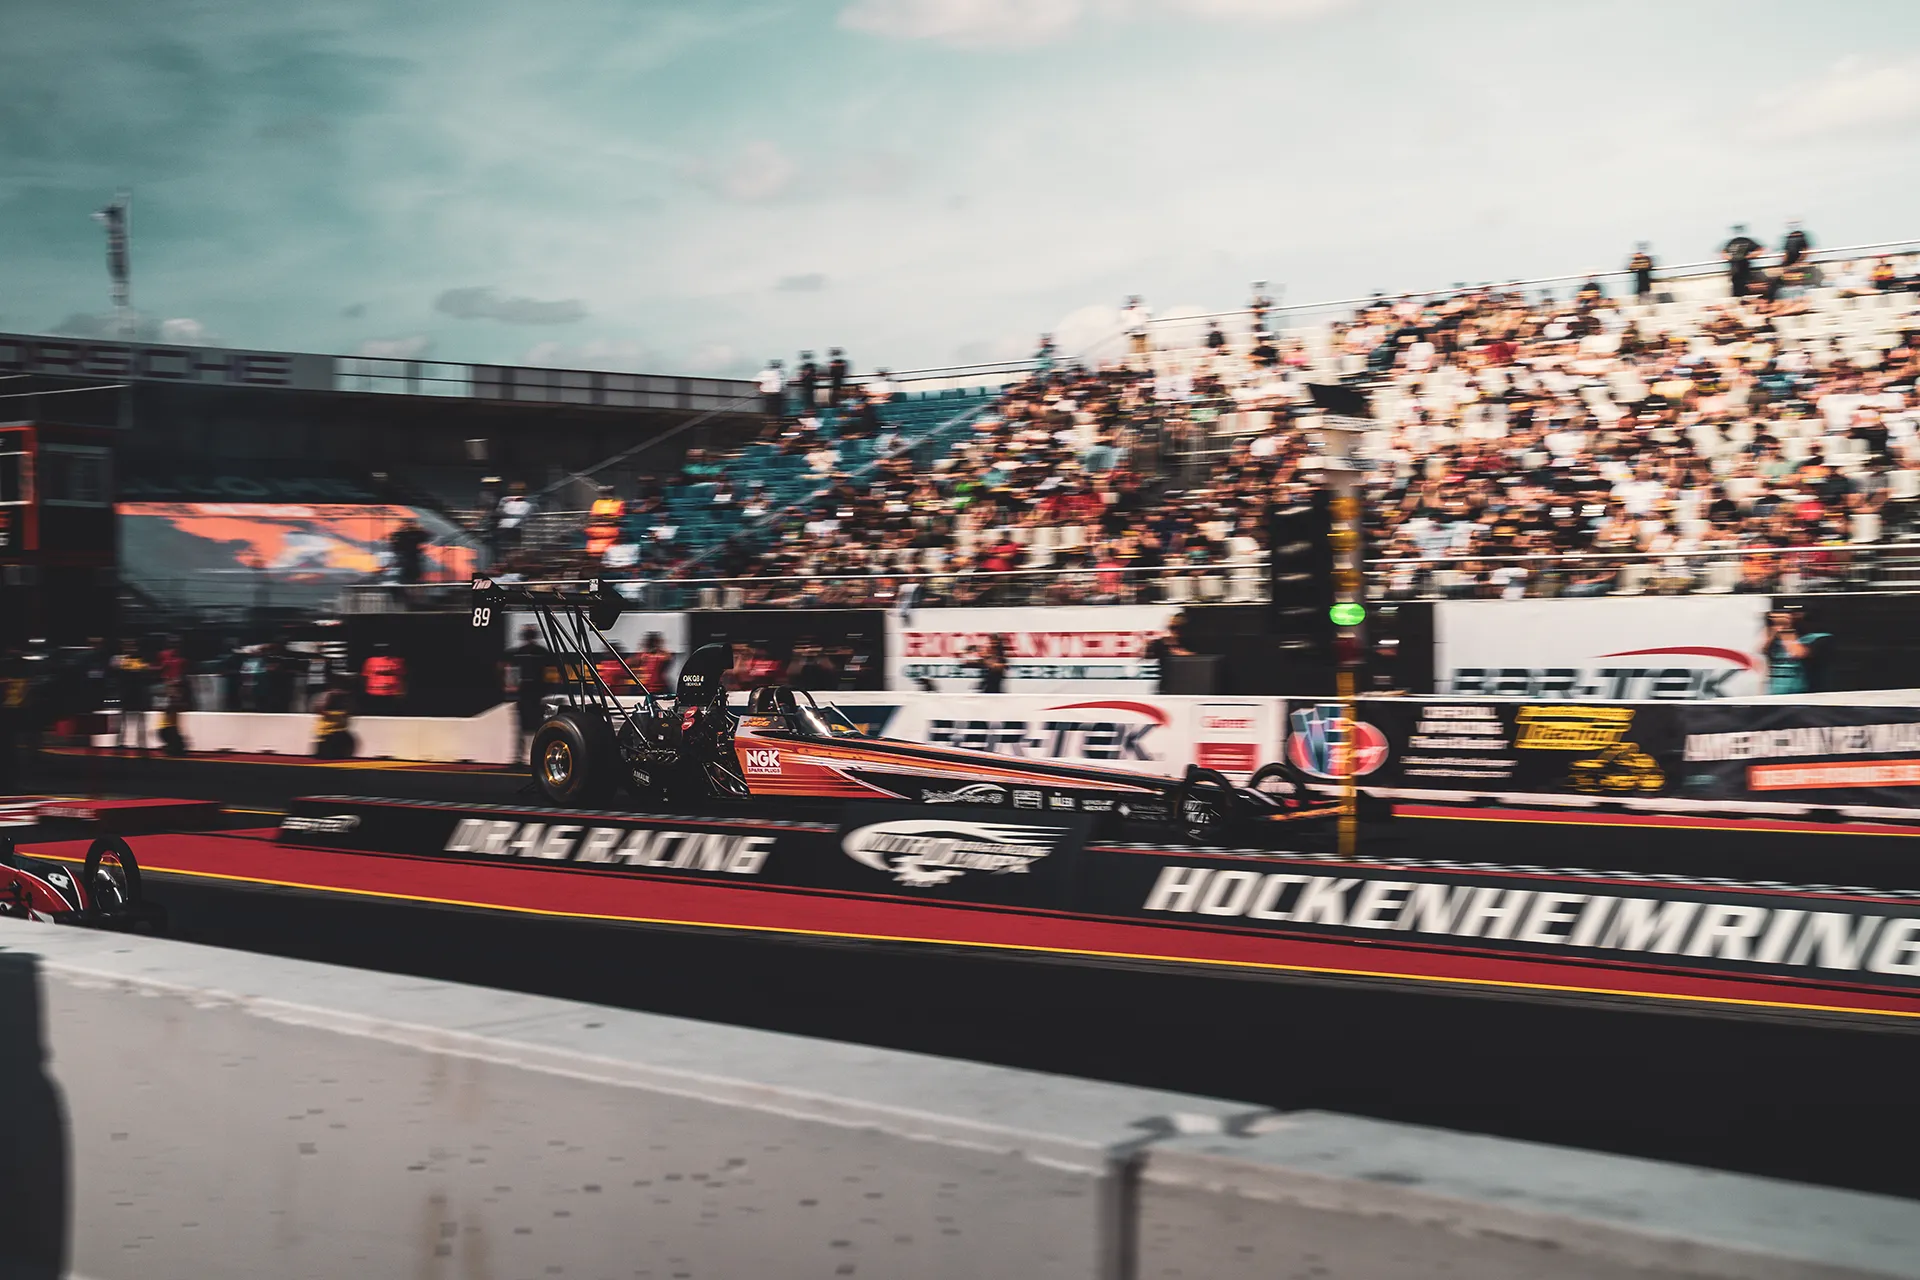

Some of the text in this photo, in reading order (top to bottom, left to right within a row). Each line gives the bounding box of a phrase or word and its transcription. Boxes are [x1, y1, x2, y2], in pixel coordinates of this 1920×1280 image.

[472, 607, 491, 627] 89
[746, 750, 780, 767] NGK
[444, 817, 778, 875] DRAG RACING
[1142, 865, 1920, 976] HOCKENHEIMRING
